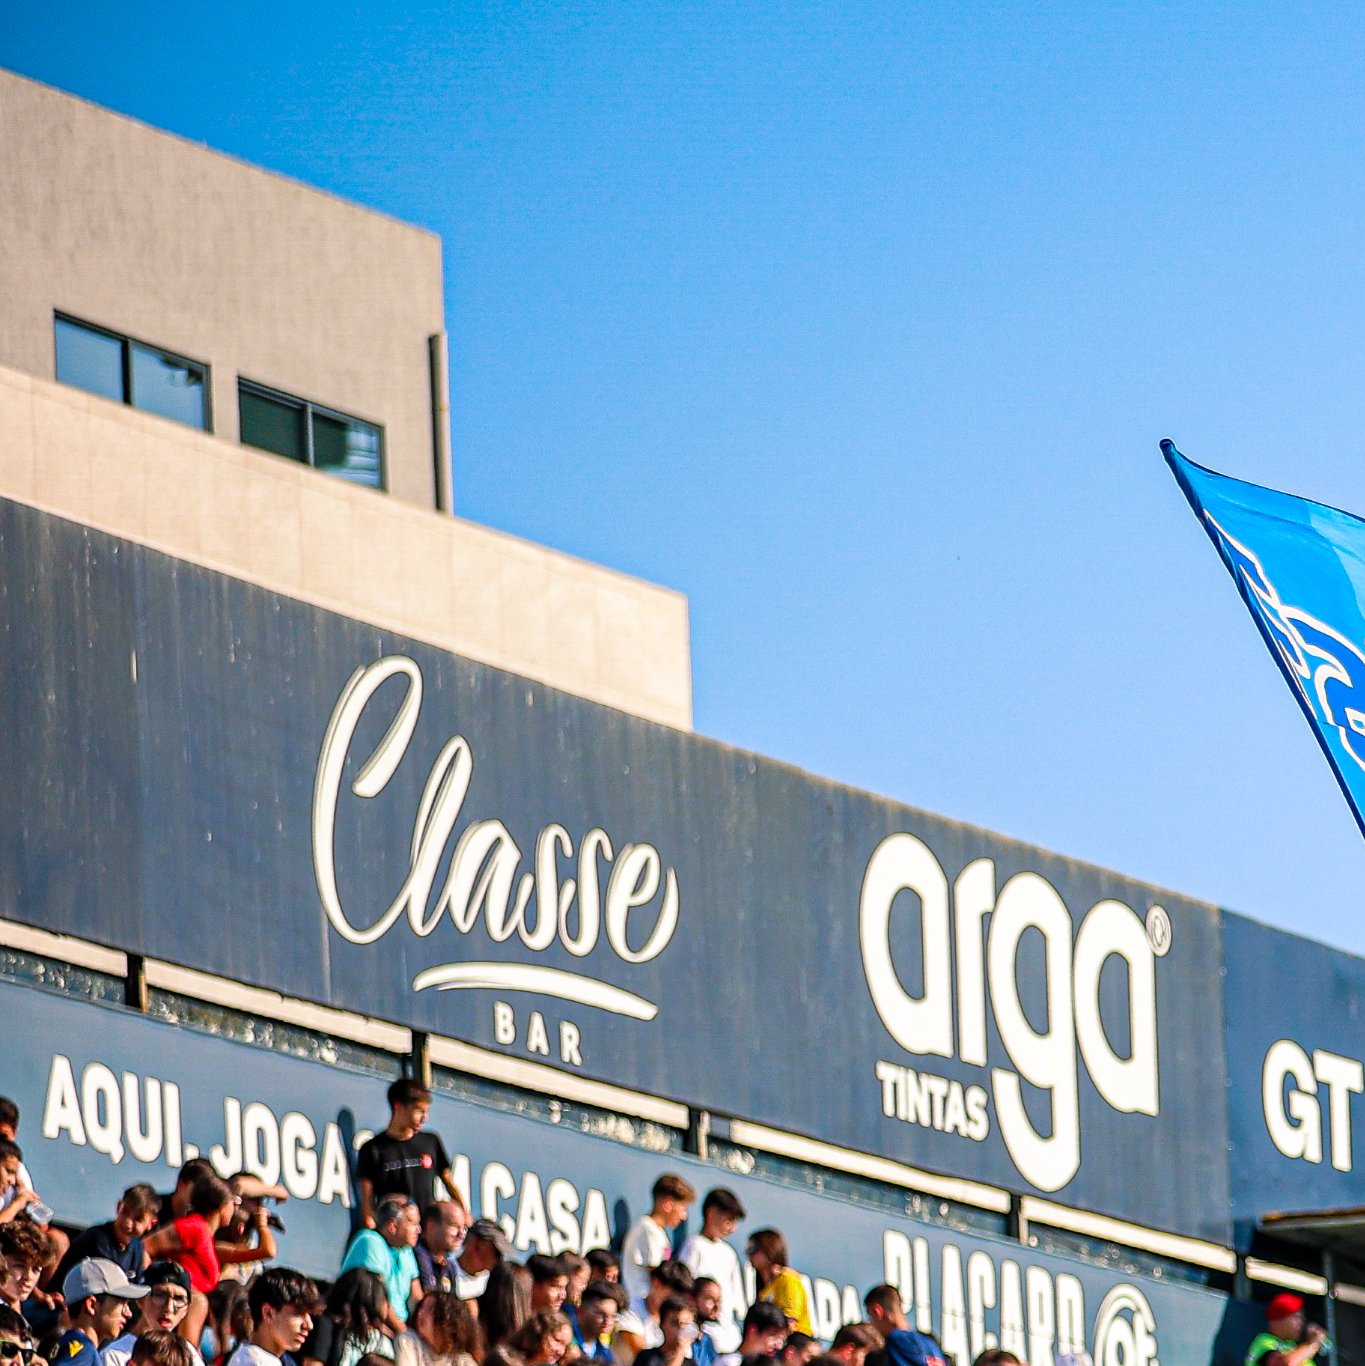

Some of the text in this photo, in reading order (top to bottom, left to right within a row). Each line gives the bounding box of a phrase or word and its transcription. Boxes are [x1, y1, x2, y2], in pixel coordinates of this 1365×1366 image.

[312, 654, 679, 964] Classe
[494, 1001, 584, 1067] BAR
[875, 1060, 990, 1142] TINTAS
[1261, 1039, 1365, 1173] GT
[480, 1161, 611, 1257] CASA
